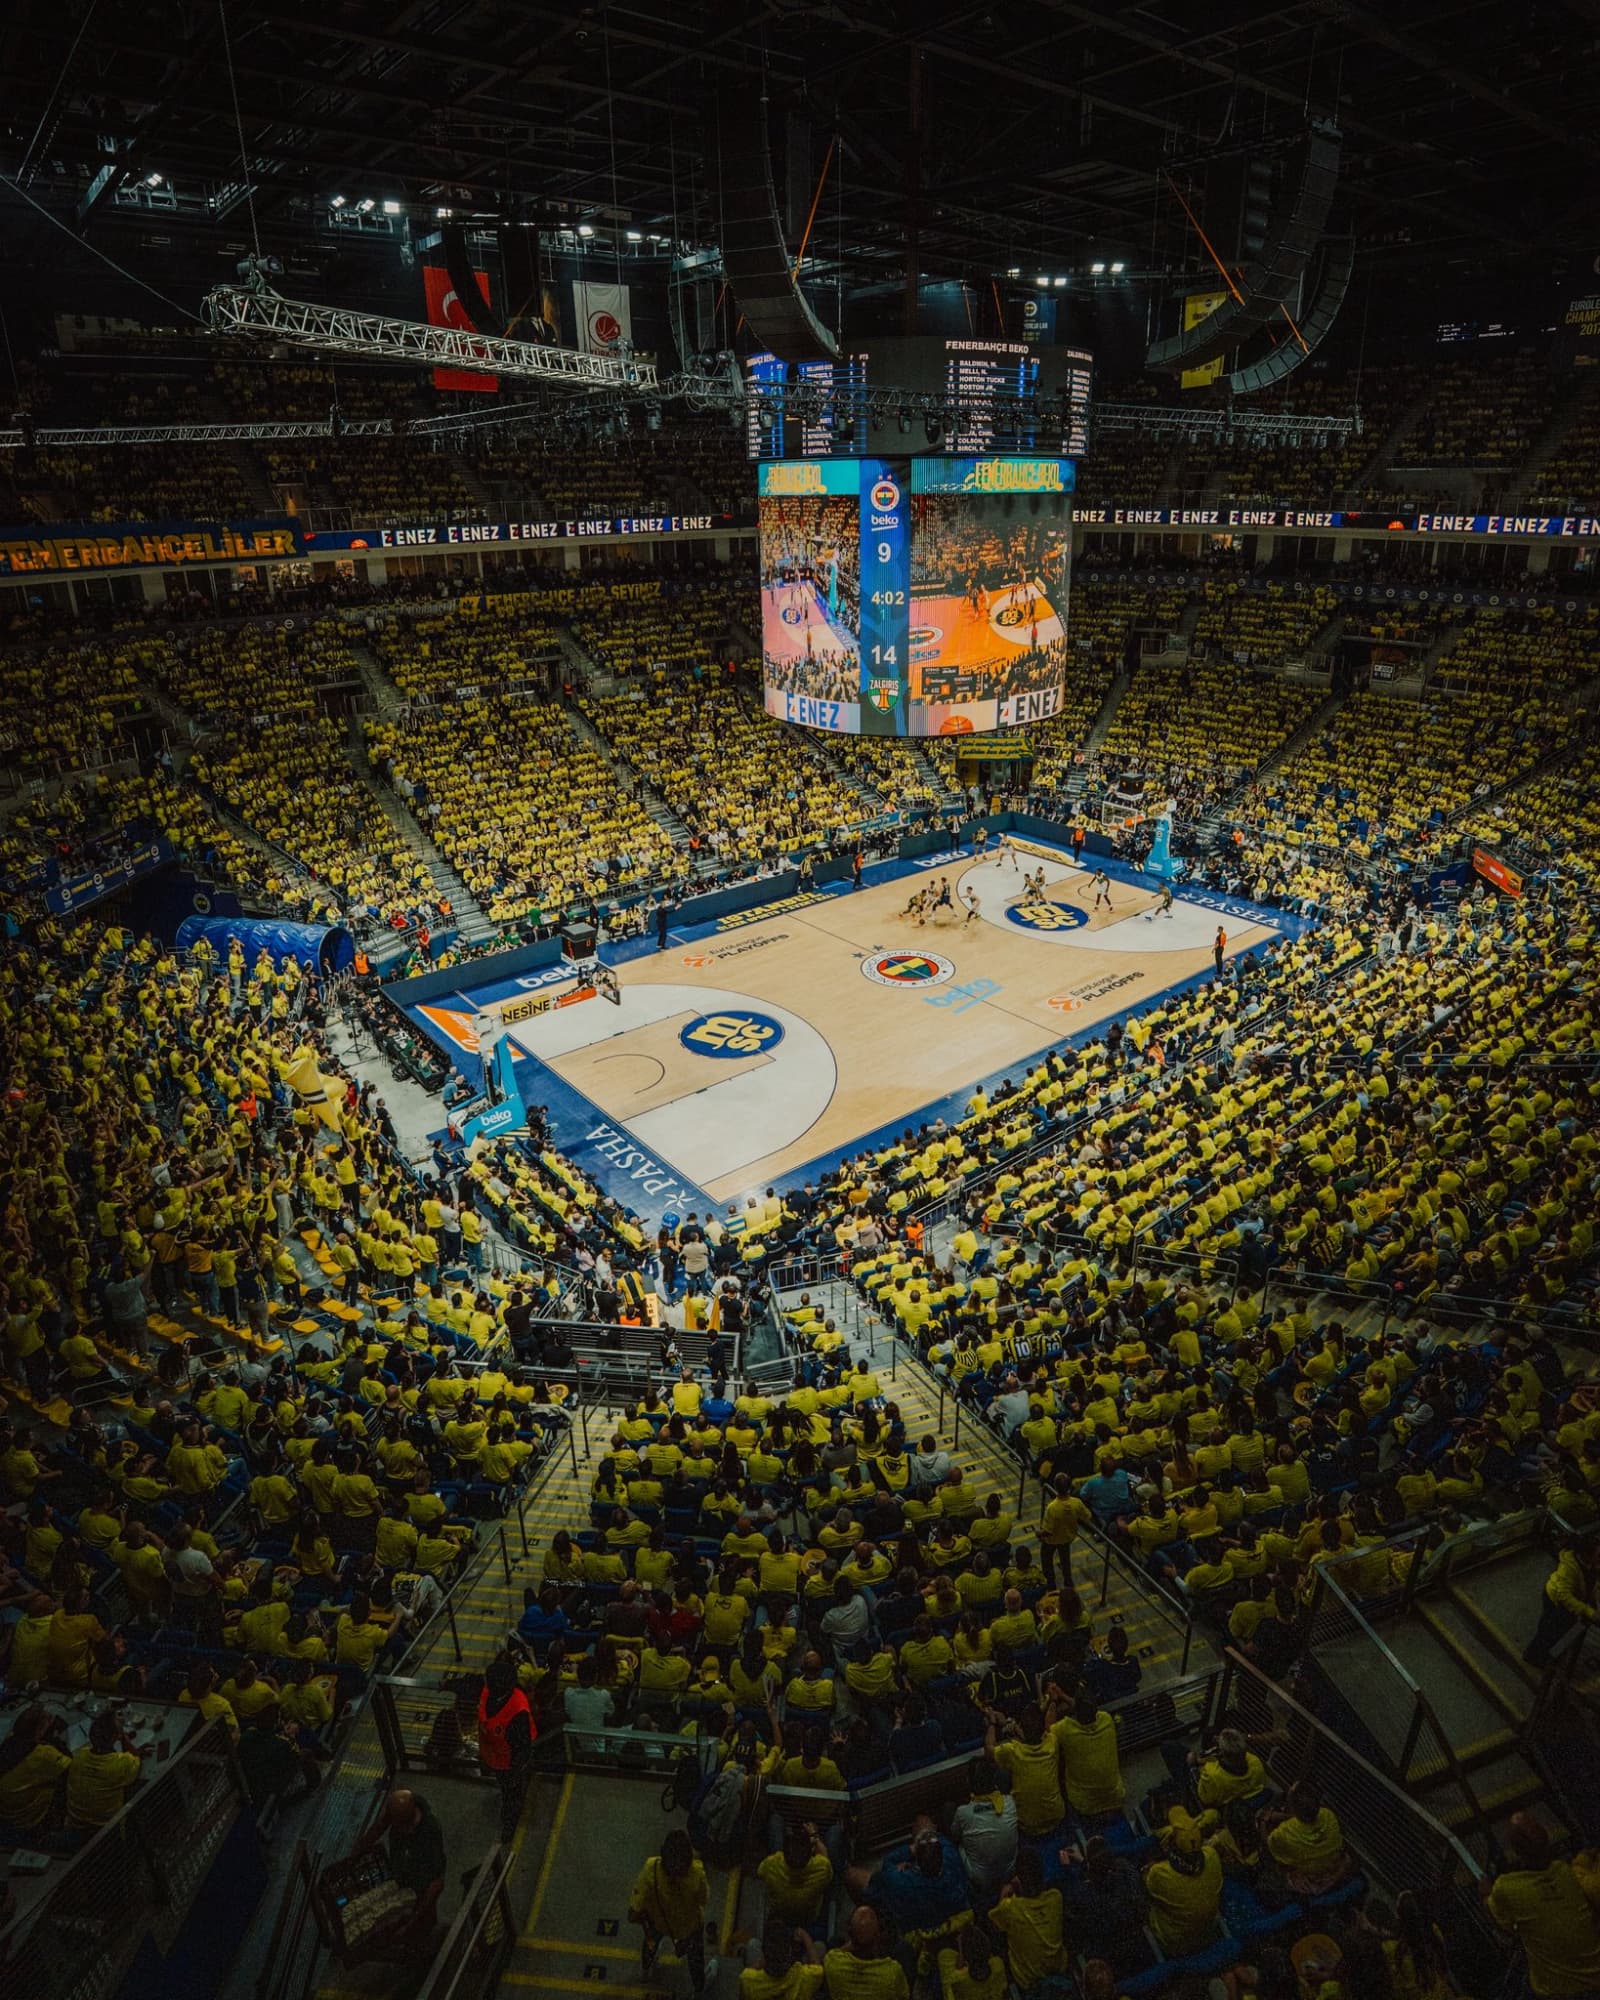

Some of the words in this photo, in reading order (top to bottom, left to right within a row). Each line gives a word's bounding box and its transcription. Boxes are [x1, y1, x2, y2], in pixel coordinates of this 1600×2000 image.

[945, 341, 1008, 354] FENERBAHÇE
[1009, 344, 1029, 354] BEKO
[682, 516, 712, 529] ENEZ
[871, 514, 899, 525] beko
[1072, 510, 1106, 522] ENEZ
[1126, 511, 1161, 523] ENEZ
[1182, 511, 1219, 524] ENEZ
[1242, 512, 1275, 525] ENEZ
[1297, 513, 1333, 527] ENEZ
[1432, 516, 1476, 531] ENEZ
[522, 521, 558, 539] ENEZ
[579, 520, 612, 535] ENEZ
[633, 518, 664, 532] ENEZ
[1503, 518, 1550, 533] ENEZ
[397, 528, 436, 545] ENEZ
[462, 526, 500, 542] ENEZ
[878, 542, 892, 563] 9
[871, 590, 905, 605] 4:02
[871, 645, 897, 665] 14
[869, 679, 899, 690] ZALGIRIS
[799, 697, 840, 729] ENEZ
[1015, 687, 1060, 723] ENEZ
[913, 849, 968, 868] beko
[1198, 897, 1281, 929] PASHA
[717, 934, 789, 959] PLAYOFFS
[925, 978, 995, 1007] beko
[1082, 971, 1145, 1001] PLAYOFFS
[480, 1109, 512, 1127] beko
[586, 1122, 679, 1197] PASHA
[1015, 1341, 1031, 1357] 10
